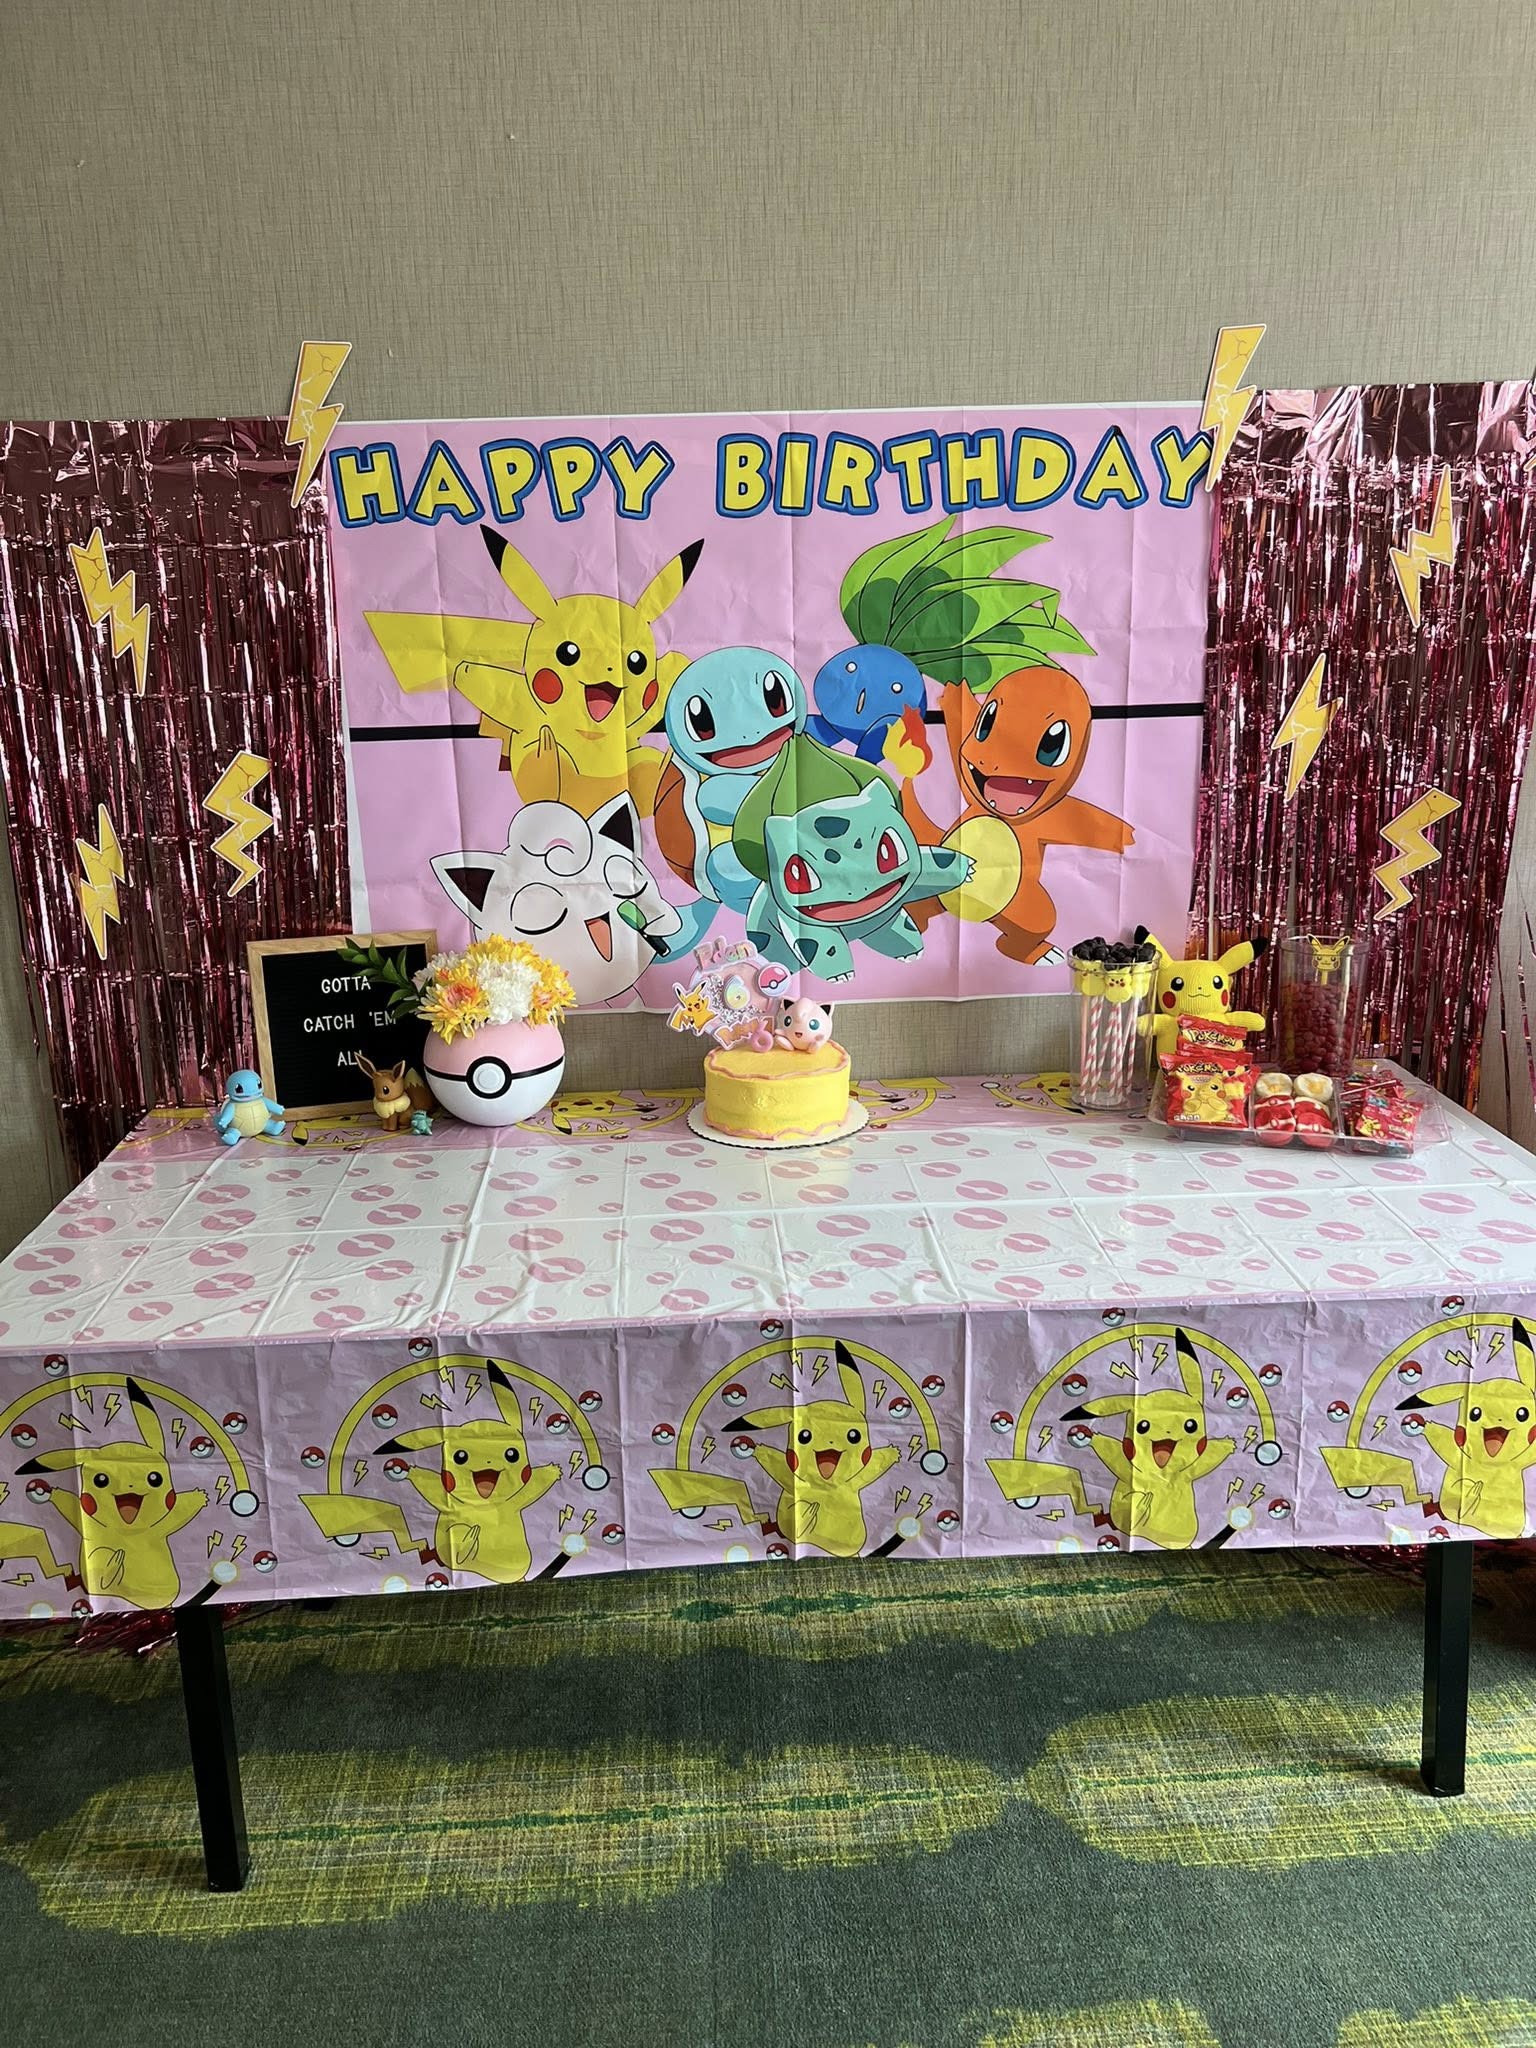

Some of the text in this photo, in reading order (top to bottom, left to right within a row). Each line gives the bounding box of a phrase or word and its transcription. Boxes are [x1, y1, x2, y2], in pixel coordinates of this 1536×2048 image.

[330, 425, 1214, 529] HAPPY BIRTHDAY
[321, 975, 371, 994] GOTTA
[303, 1009, 397, 1033] CATCH 'EM
